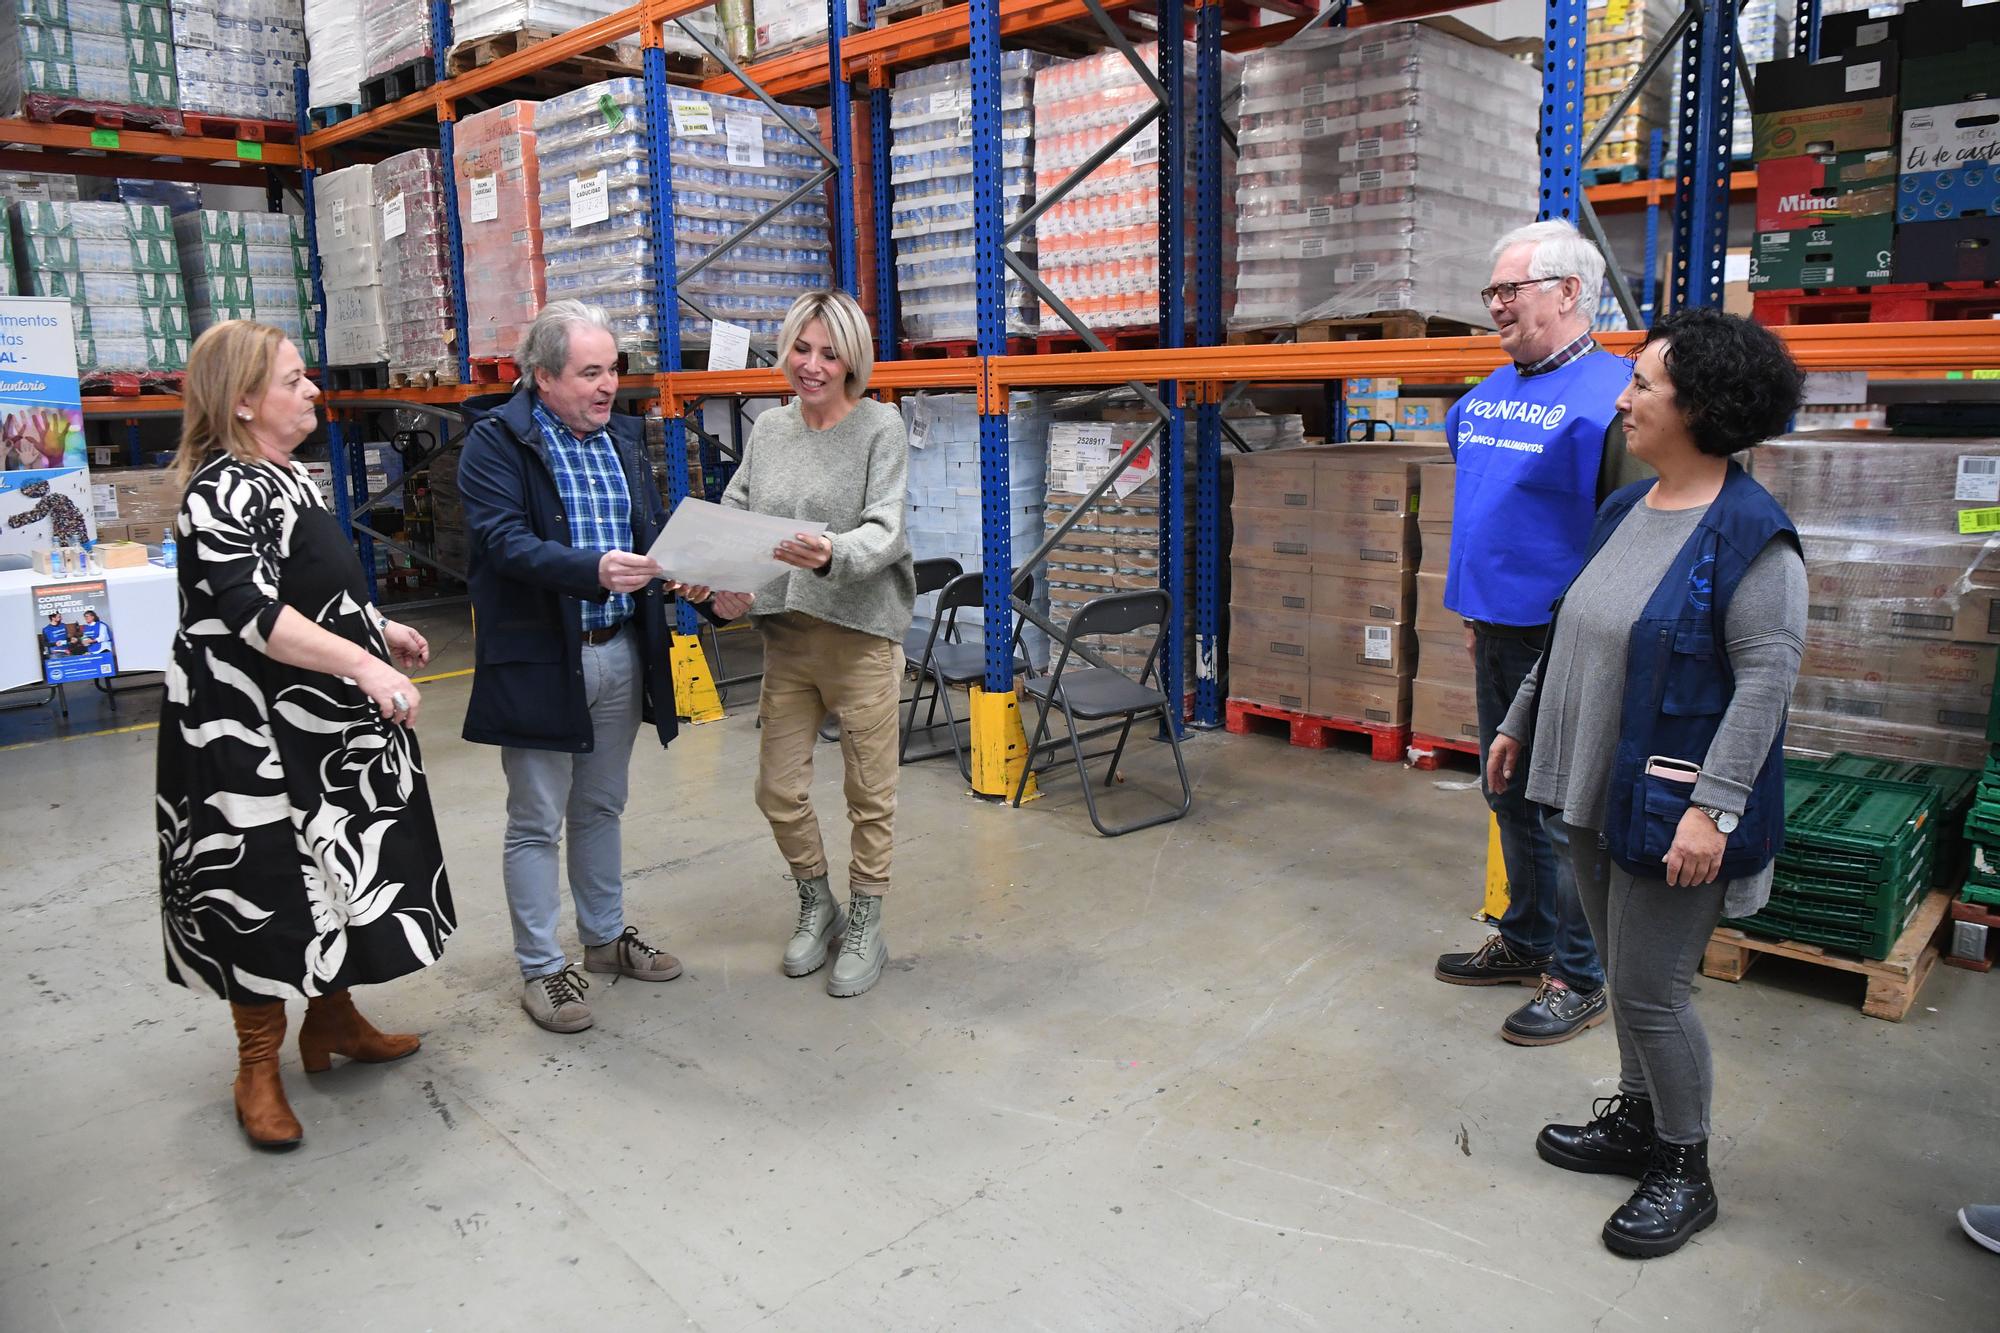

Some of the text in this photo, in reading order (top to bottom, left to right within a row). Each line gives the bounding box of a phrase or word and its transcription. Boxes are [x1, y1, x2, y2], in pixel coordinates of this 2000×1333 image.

[1932, 145, 1952, 167] de
[581, 181, 595, 189] FECHA
[576, 187, 601, 198] CADUCIDAD
[1778, 193, 1839, 213] Mima
[1077, 437, 1105, 446] 2528917
[38, 594, 72, 603] COMER
[38, 599, 83, 611] NO PUEDE
[1939, 645, 1978, 662] eliges
